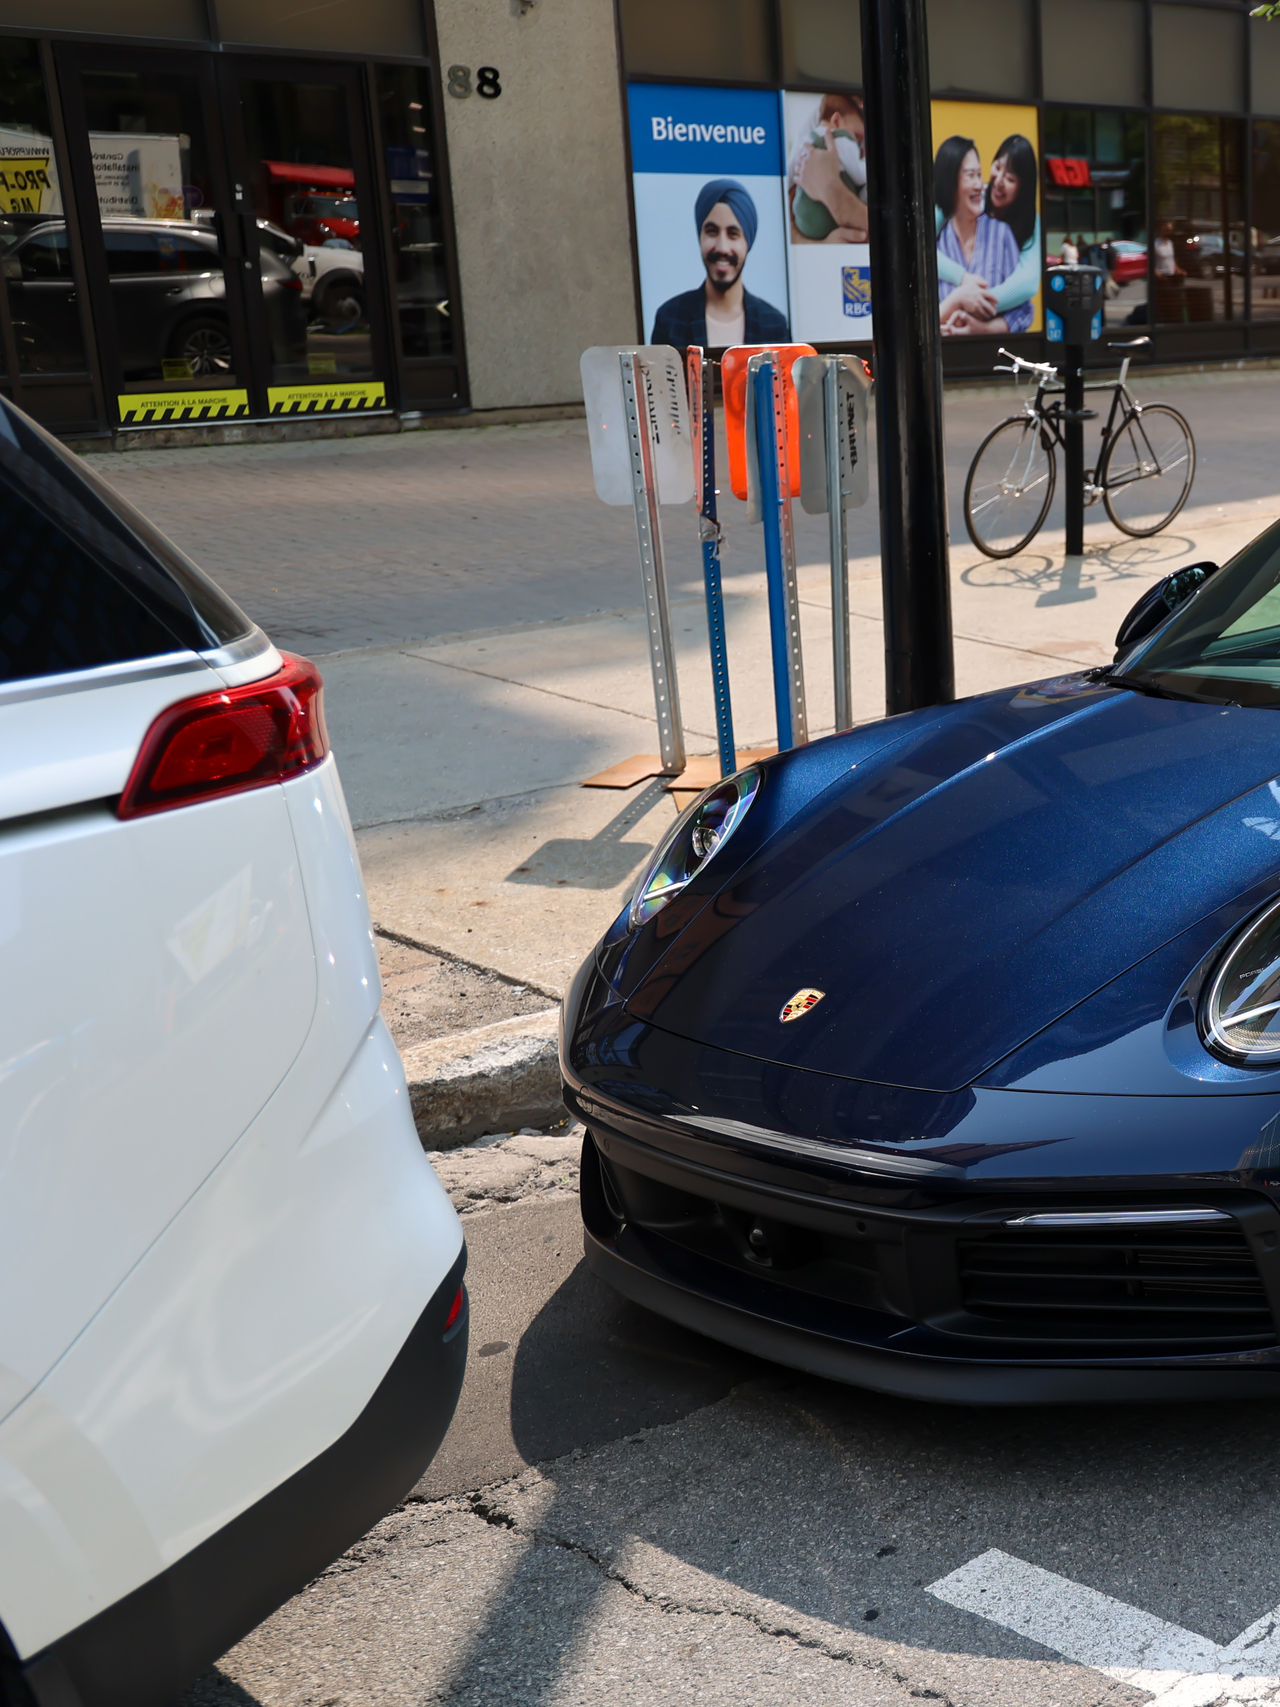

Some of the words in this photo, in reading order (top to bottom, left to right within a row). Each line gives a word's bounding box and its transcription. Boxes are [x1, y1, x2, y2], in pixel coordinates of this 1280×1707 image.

[448, 65, 502, 99] 88
[650, 115, 766, 145] Bienvenue
[845, 302, 871, 315] RBC
[140, 400, 180, 408] ATTENTION
[181, 398, 187, 406] À
[339, 389, 367, 397] MARCHE
[666, 364, 681, 435] Groupe
[847, 391, 858, 470] BRUNET
